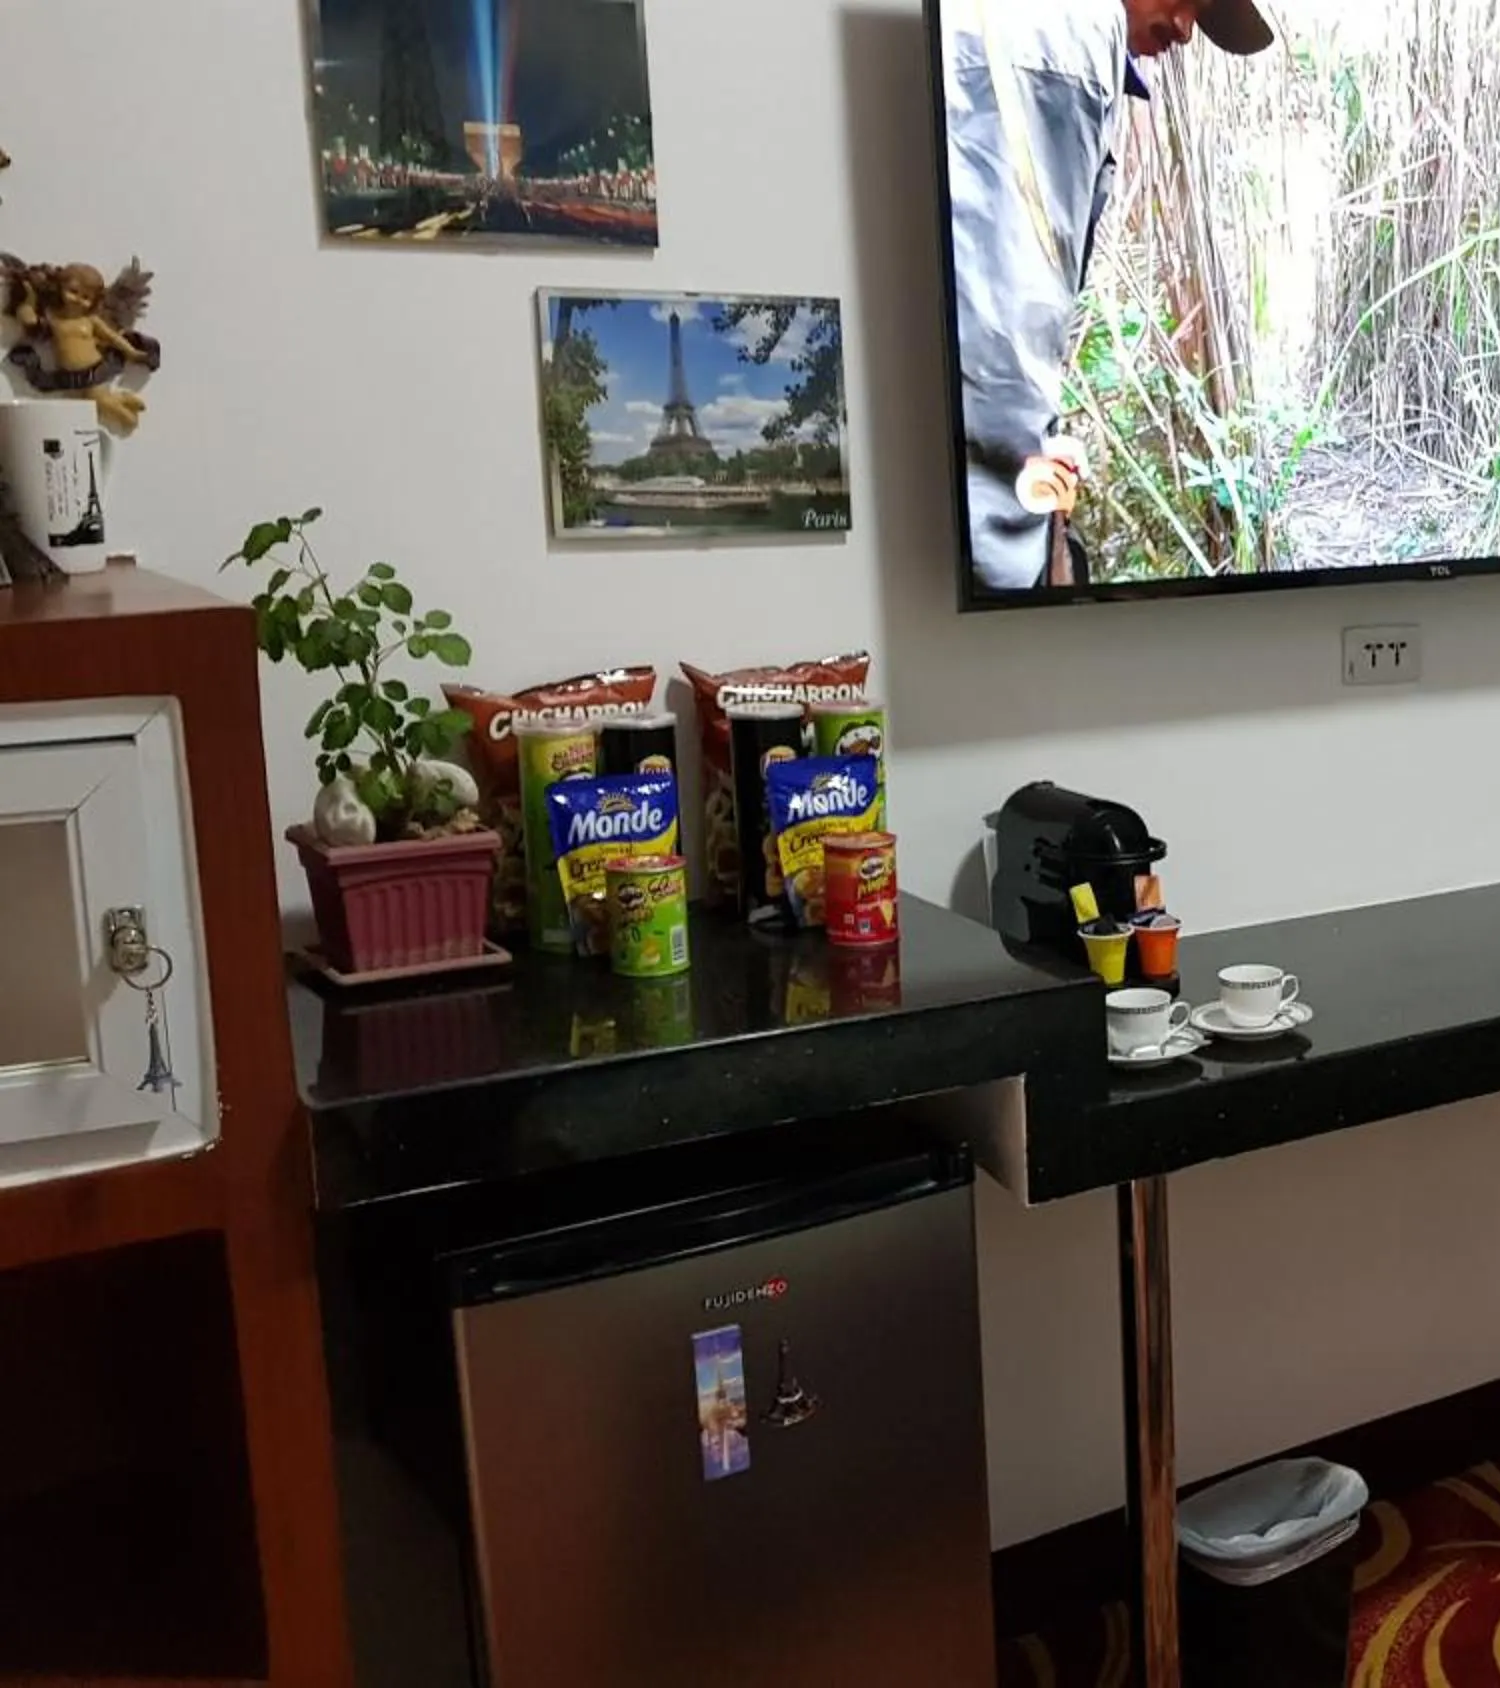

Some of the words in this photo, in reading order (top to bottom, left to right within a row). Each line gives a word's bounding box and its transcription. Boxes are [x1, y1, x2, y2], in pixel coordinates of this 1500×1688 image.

[802, 508, 847, 529] Paris
[1430, 565, 1451, 577] TCL
[787, 778, 868, 823] Monde
[568, 800, 663, 845] Monde
[704, 1280, 788, 1310] FUJIDENZO
